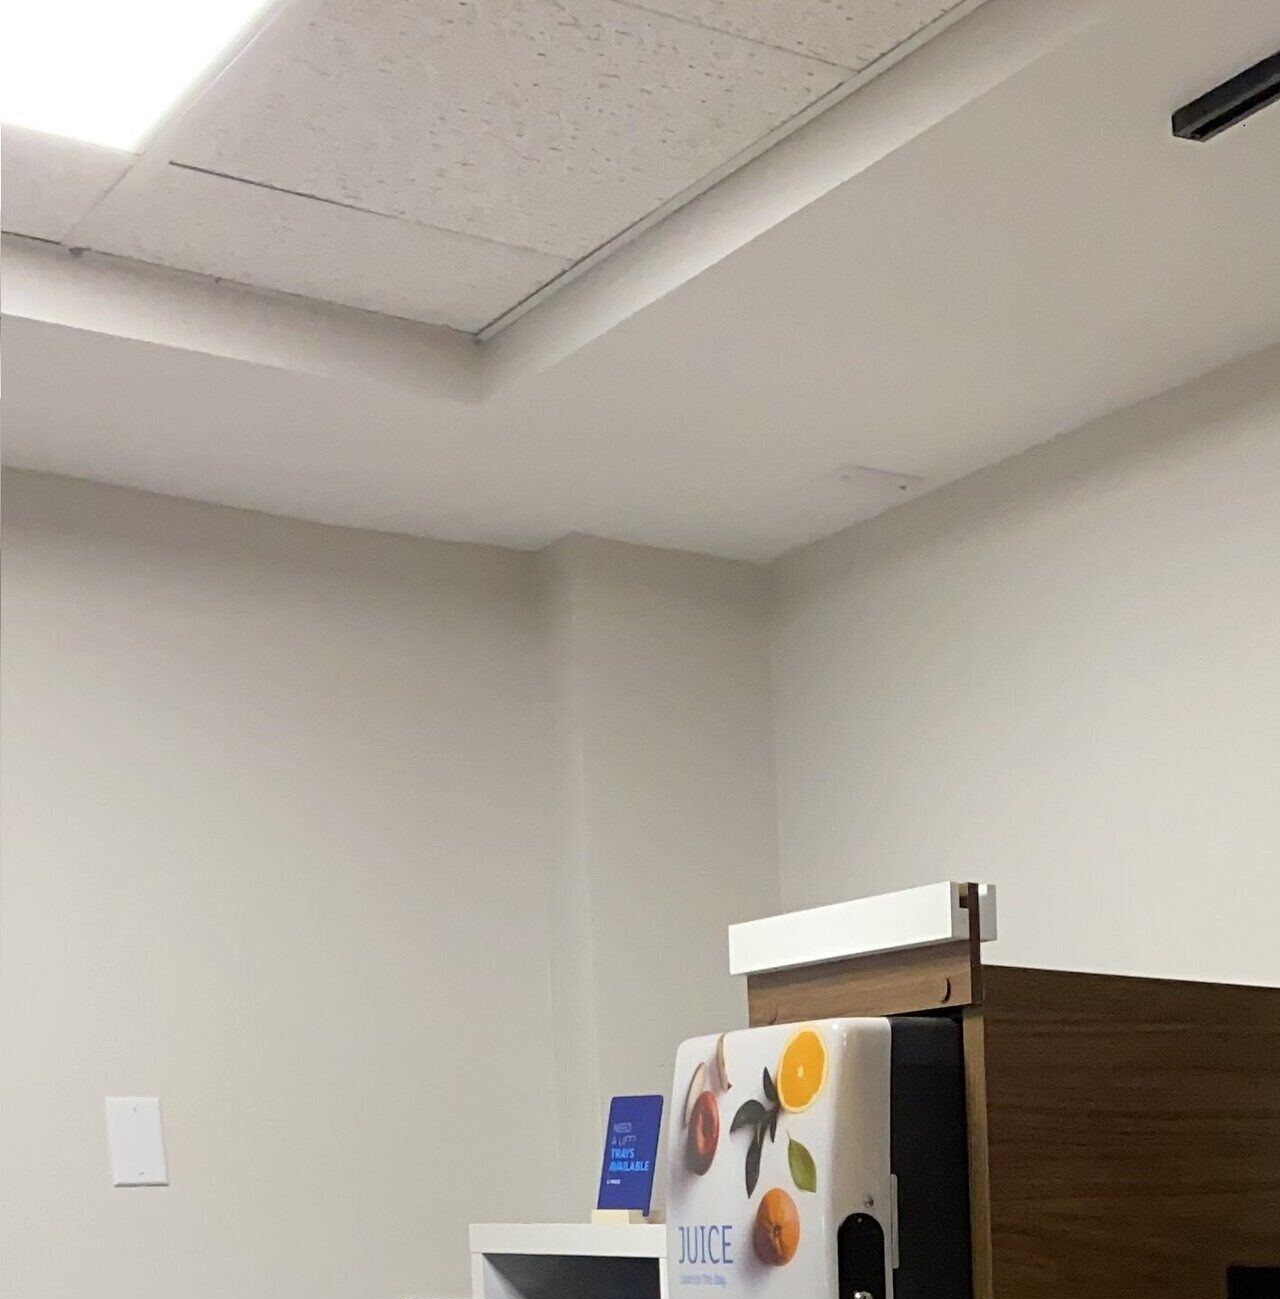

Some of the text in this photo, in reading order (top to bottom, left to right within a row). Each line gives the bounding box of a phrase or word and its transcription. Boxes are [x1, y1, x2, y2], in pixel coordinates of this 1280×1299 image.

[611, 1148, 635, 1159] TRAYS
[608, 1161, 650, 1172] AVAILABLE
[678, 1225, 734, 1265] JUICE
